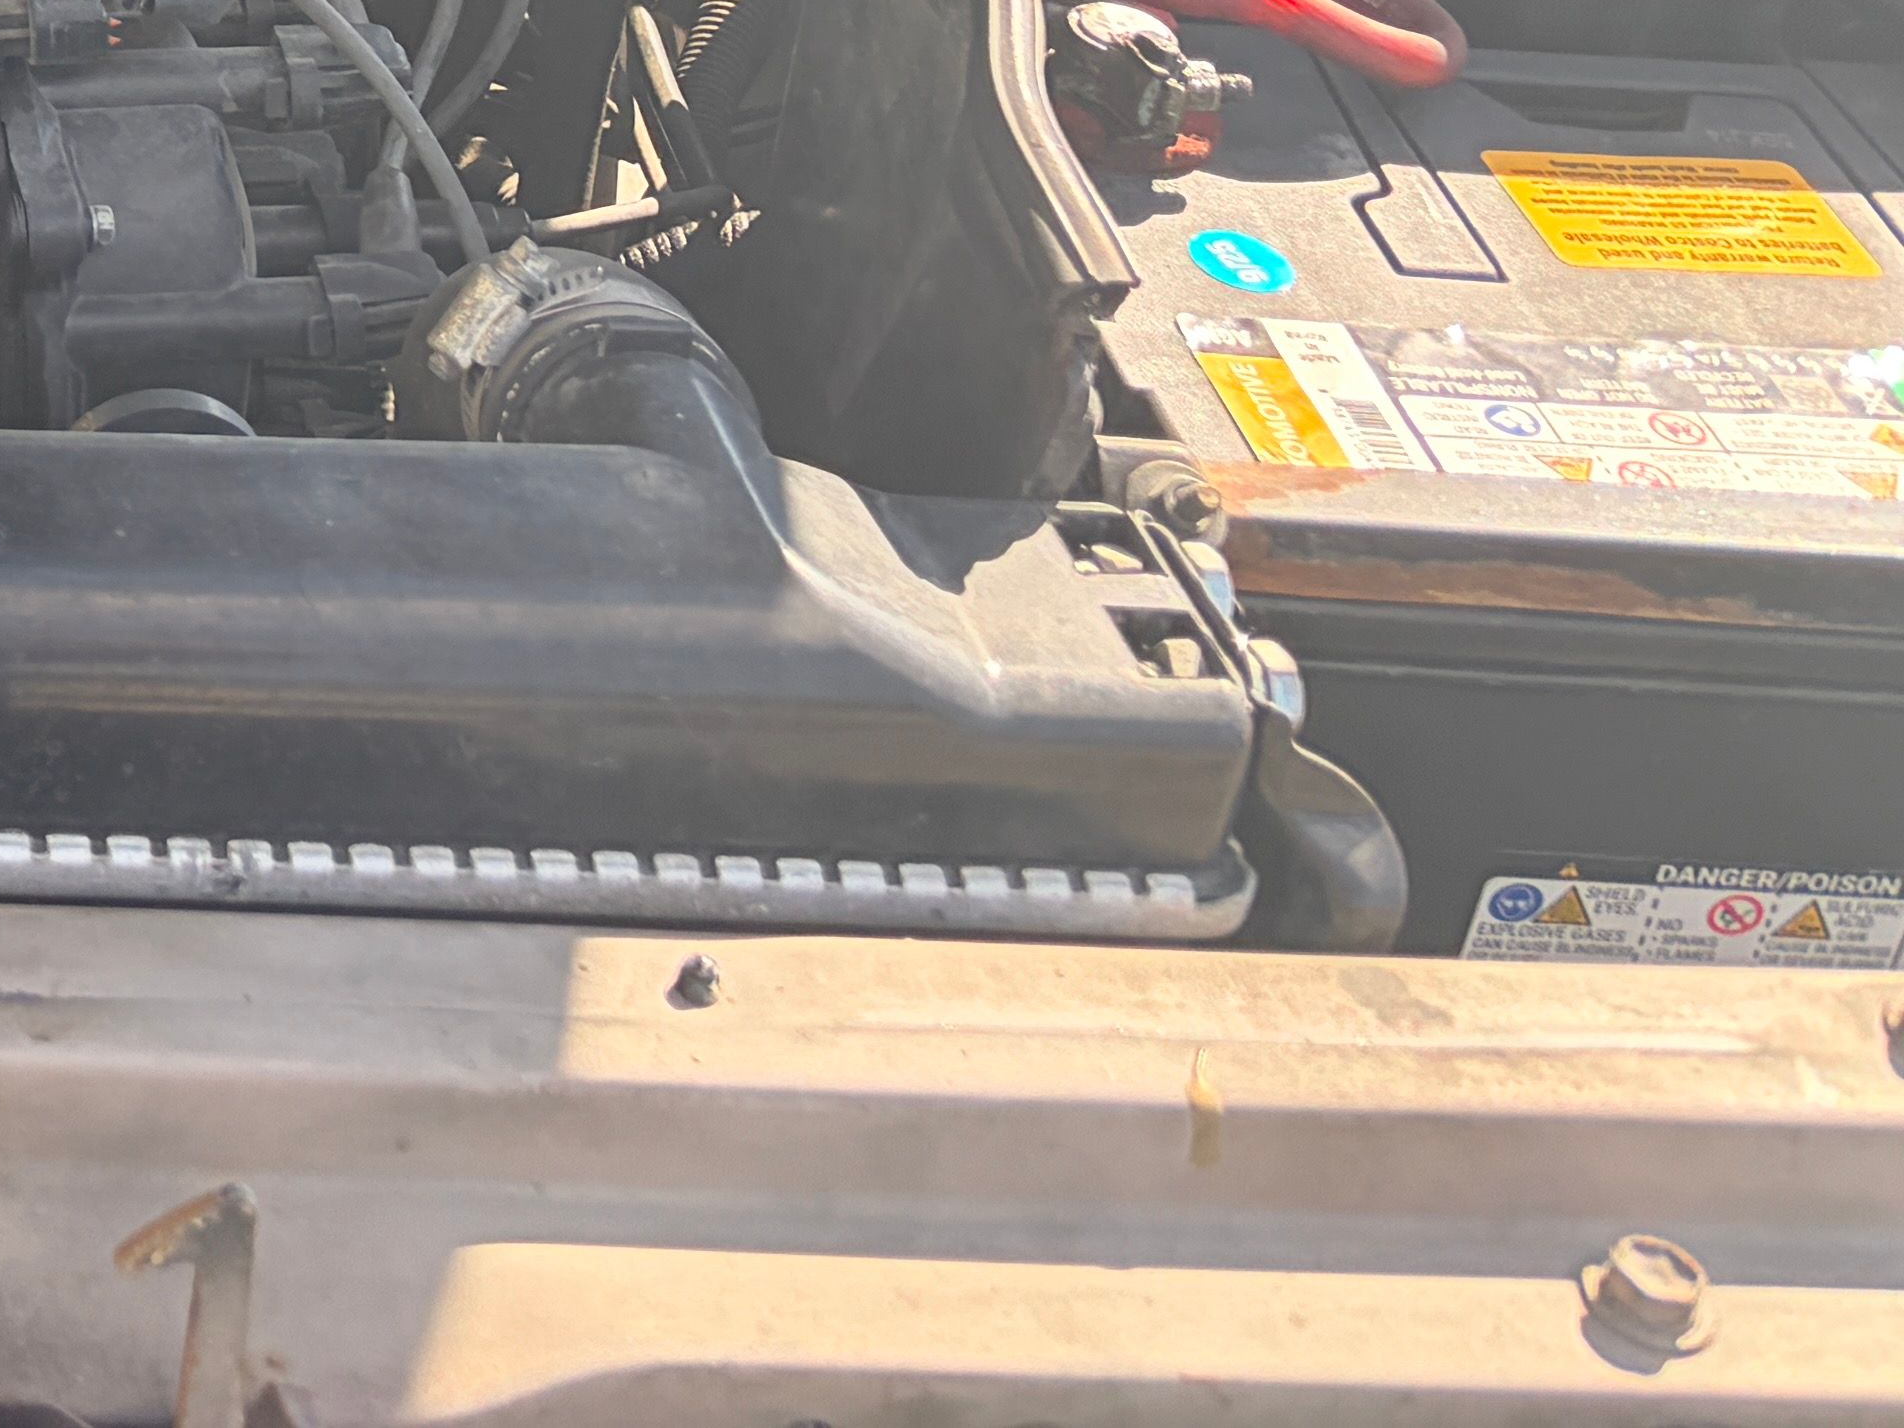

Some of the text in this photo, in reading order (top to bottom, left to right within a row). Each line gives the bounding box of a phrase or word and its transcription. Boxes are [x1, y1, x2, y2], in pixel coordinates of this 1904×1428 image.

[1562, 230, 1848, 255] batteries to Costco Wholesale
[1596, 247, 1842, 269] Return warranty and used
[1656, 864, 1903, 896] DANGER/POISON
[1585, 886, 1647, 902] SHIELD
[1477, 921, 1627, 943] EXPLOSIVE GASES
[1656, 918, 1684, 931] NO
[1472, 938, 1503, 950] CAN
[1505, 940, 1552, 953] CAUSE
[1655, 947, 1716, 962] FLAMES
